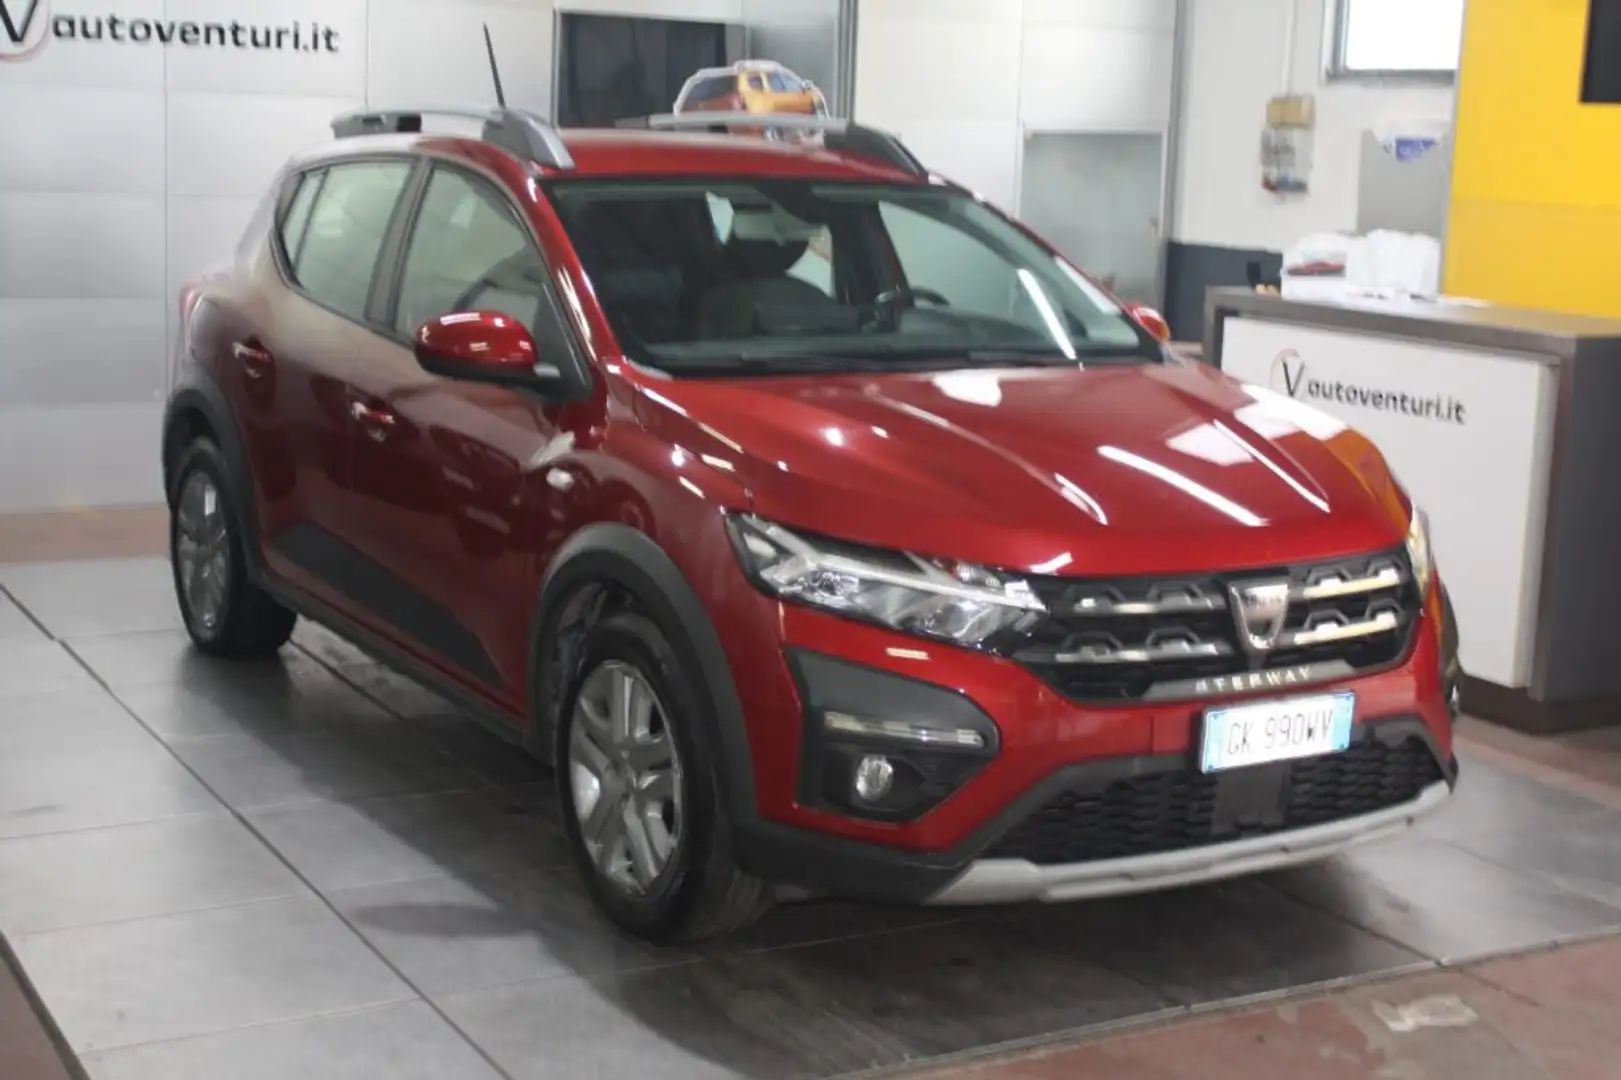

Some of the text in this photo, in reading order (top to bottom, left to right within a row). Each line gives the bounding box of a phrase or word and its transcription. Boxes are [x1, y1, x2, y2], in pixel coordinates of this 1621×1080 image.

[51, 13, 340, 52] autoventuri.it
[1307, 378, 1466, 424] autoventuri.it
[1228, 720, 1254, 755] GK
